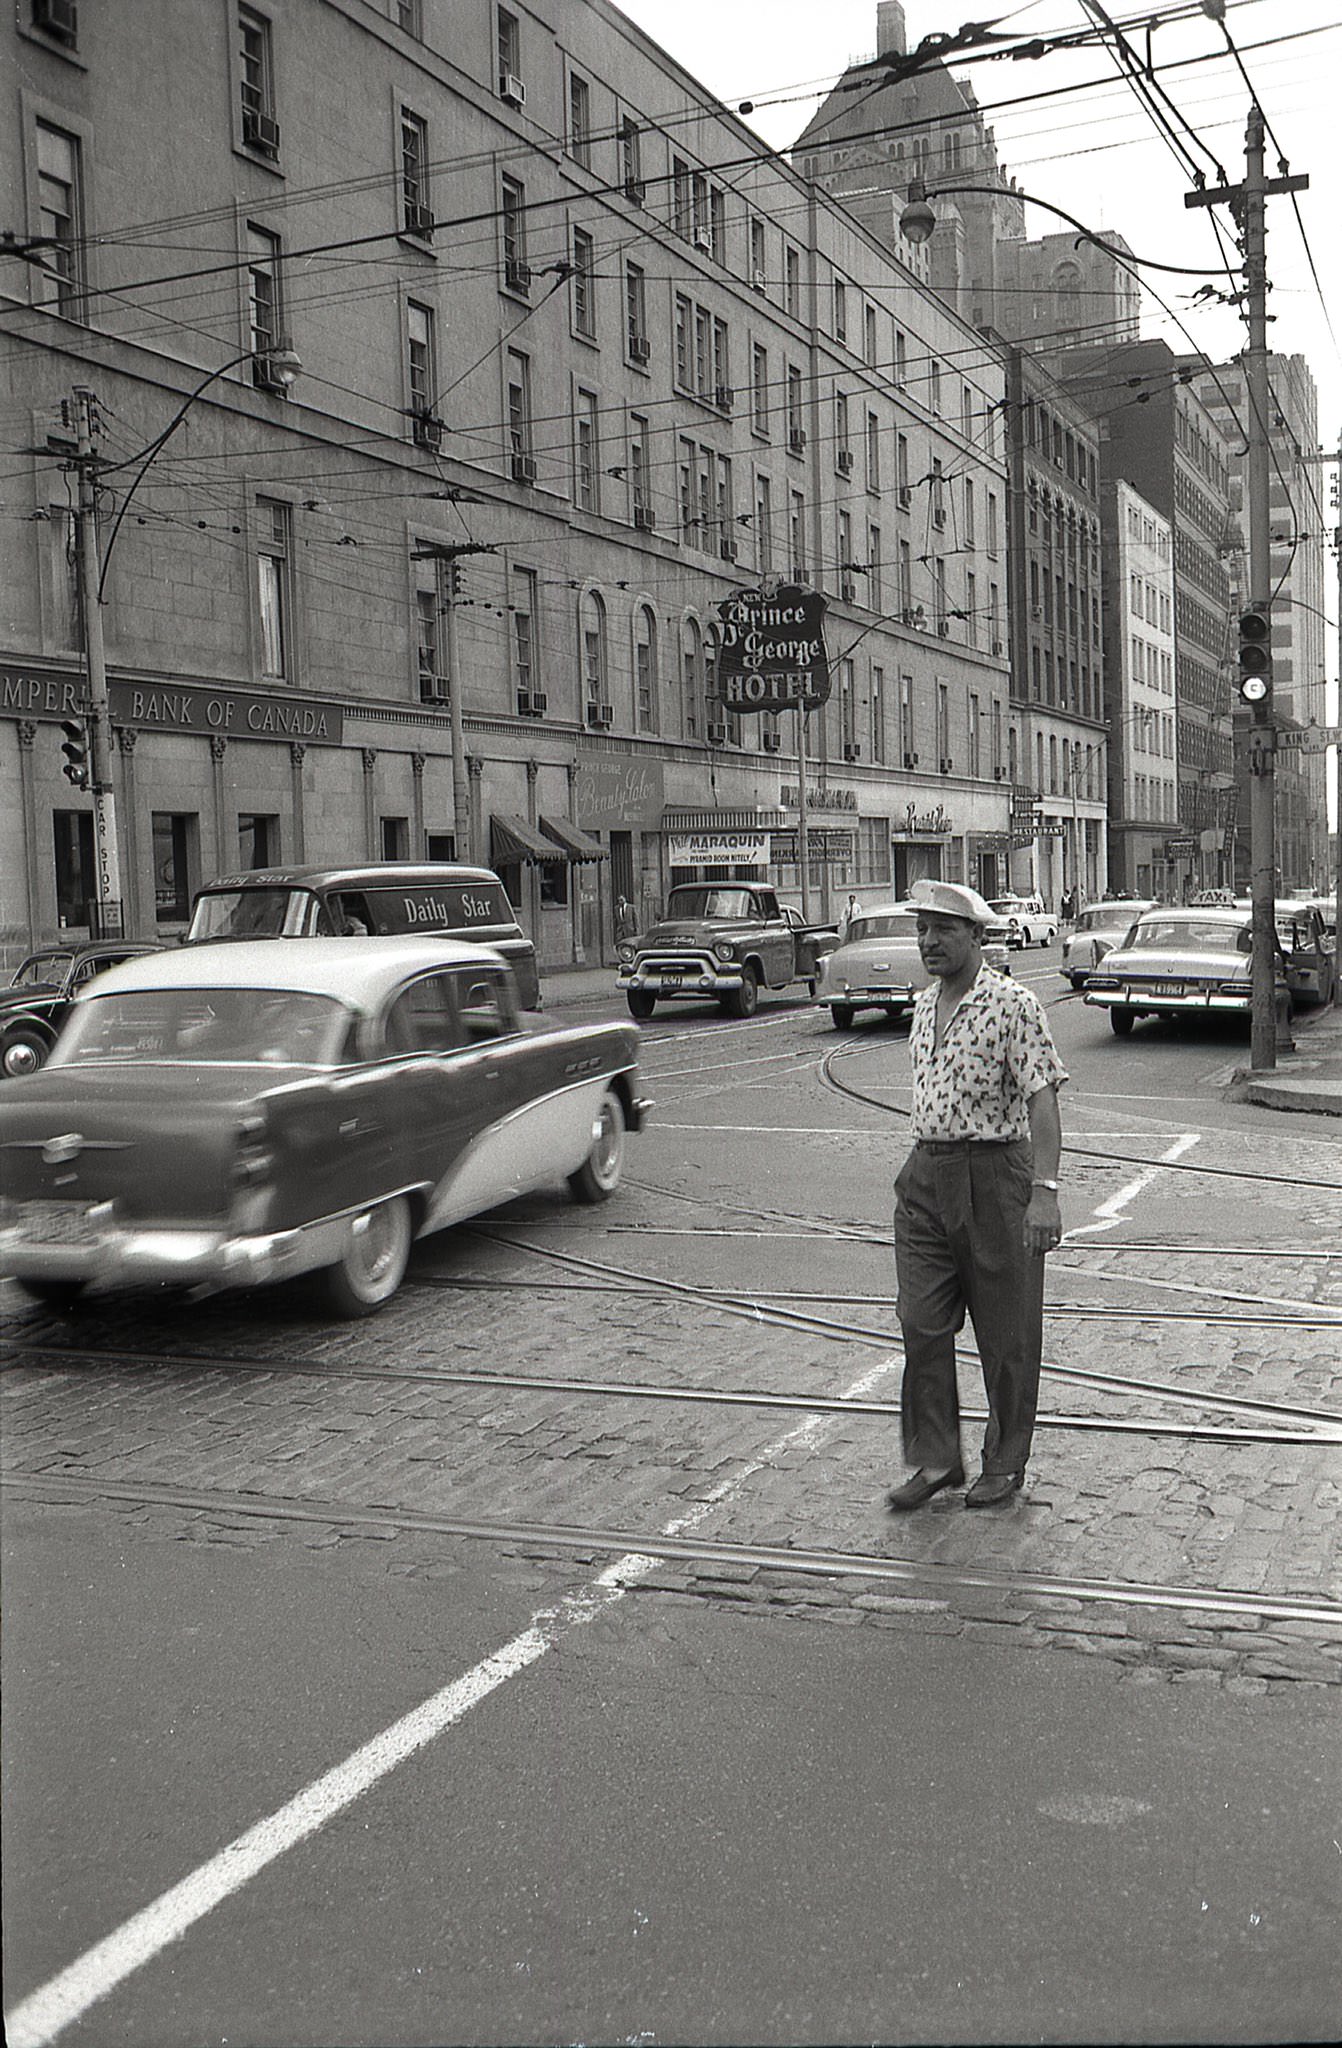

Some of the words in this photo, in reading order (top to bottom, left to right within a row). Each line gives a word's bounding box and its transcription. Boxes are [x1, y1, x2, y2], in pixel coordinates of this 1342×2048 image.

[742, 593, 761, 602] NEW
[727, 601, 806, 626] Prince
[743, 629, 820, 671] George
[726, 672, 821, 702] HOTEL
[131, 691, 192, 724] BANK
[205, 699, 234, 727] OF
[247, 703, 328, 737] CANADA
[1285, 732, 1310, 745] KING
[579, 777, 627, 820] Beauty
[97, 799, 107, 837] CAR
[1014, 827, 1063, 836] RESTAURANT
[689, 834, 765, 849] MARAQUIN
[100, 848, 110, 898] STOP
[208, 876, 249, 886] Daily
[256, 874, 294, 883] Star
[403, 896, 449, 927] Daily
[461, 893, 491, 918] Star
[1199, 891, 1227, 903] TAXI
